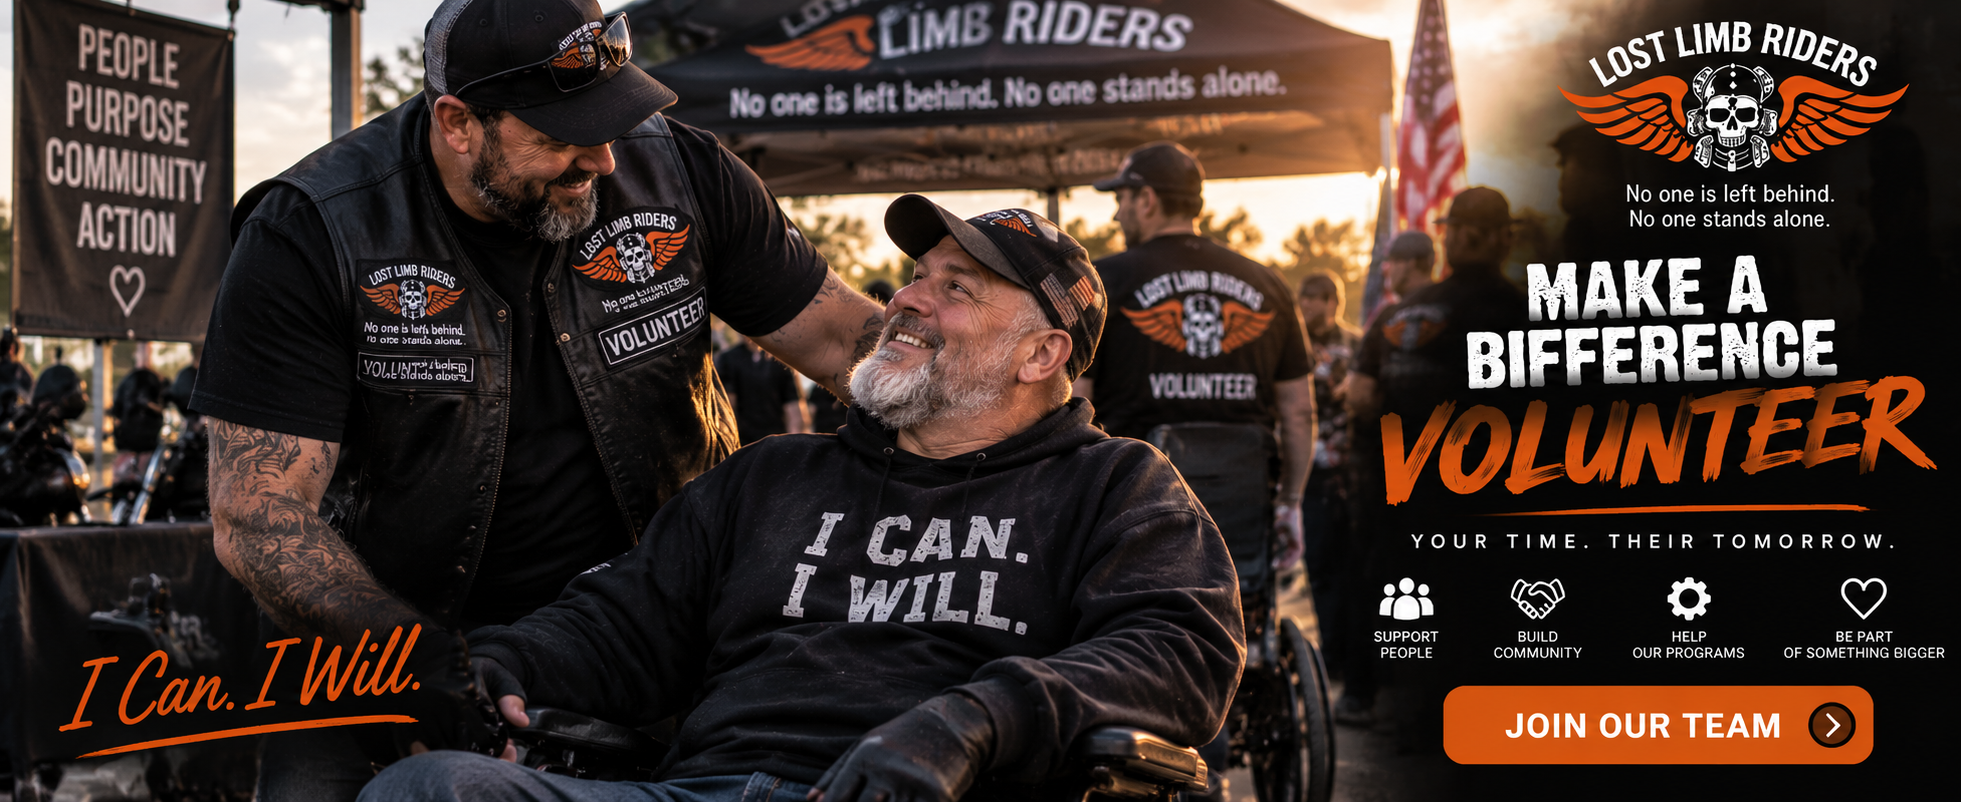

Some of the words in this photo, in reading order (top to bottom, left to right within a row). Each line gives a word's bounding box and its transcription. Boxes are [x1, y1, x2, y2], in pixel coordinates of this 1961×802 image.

[1002, 0, 1193, 51] RIDERS
[78, 24, 180, 89] PEOPLE
[66, 80, 189, 147] PURPOSE
[729, 87, 766, 119] No
[770, 91, 820, 117] one
[824, 83, 849, 115] is
[854, 82, 899, 114] left
[903, 77, 999, 112] behind.
[1003, 76, 1042, 108] No
[1046, 80, 1097, 106] one
[1102, 67, 1196, 104] stands
[1201, 64, 1287, 98] alone.
[45, 136, 207, 204] COMMUNITY
[76, 201, 176, 258] ACTION
[605, 215, 632, 237] LIMB
[633, 212, 677, 230] RIDERS
[369, 267, 392, 286] LOST
[394, 264, 418, 278] LIMB
[363, 321, 379, 334] No
[380, 324, 399, 334] one
[605, 296, 705, 356] VOLUNTEER
[1149, 373, 1257, 399] VOLUNTEER
[804, 512, 845, 557] I
[866, 514, 1028, 567] CAN.
[782, 563, 817, 618] I
[848, 570, 1028, 635] WILL.
